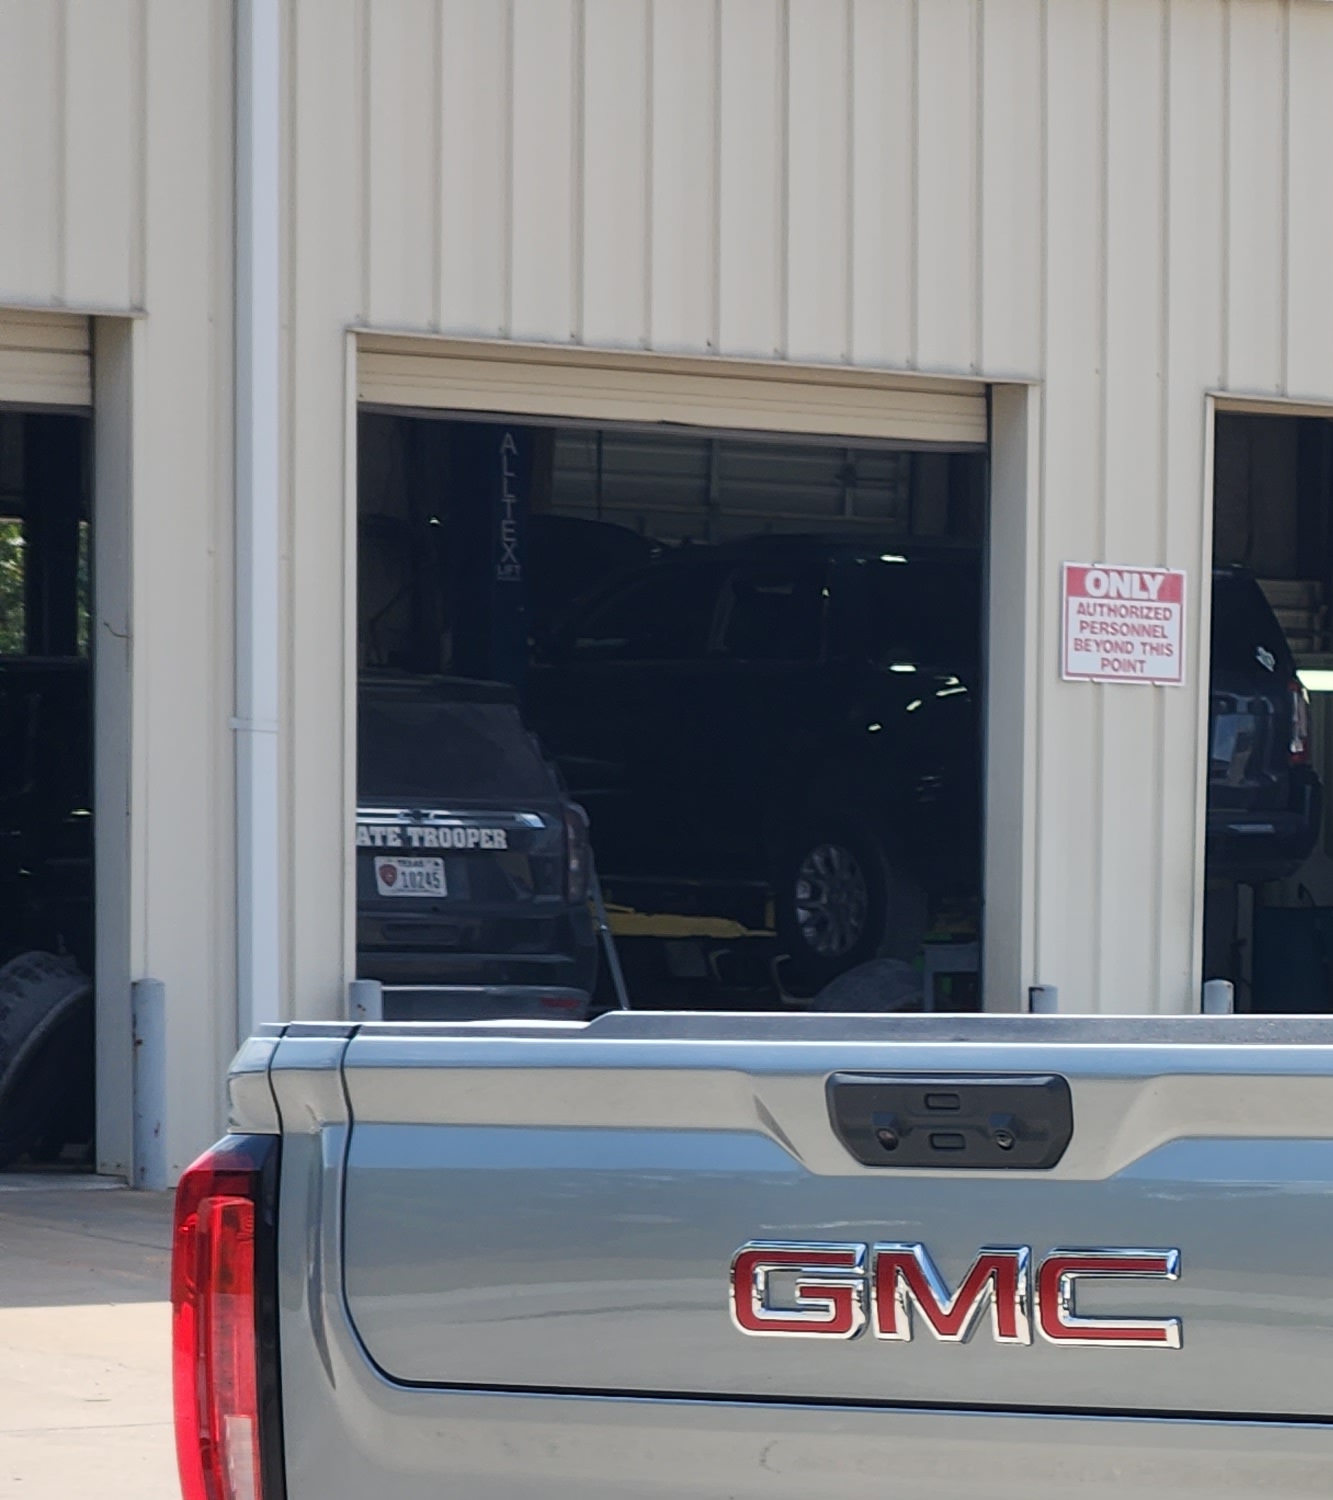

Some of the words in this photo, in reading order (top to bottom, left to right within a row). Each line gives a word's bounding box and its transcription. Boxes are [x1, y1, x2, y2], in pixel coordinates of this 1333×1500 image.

[1084, 569, 1165, 601] ONLY
[1076, 602, 1173, 621] AUTHORIZED
[1079, 619, 1168, 639] PERSONNEL
[1073, 637, 1134, 655] BEYOND
[1140, 641, 1174, 657] THIS
[1100, 657, 1147, 674] POINT
[407, 827, 508, 849] TROOPER
[400, 869, 441, 890] 10245
[729, 1239, 1184, 1350] GMC
